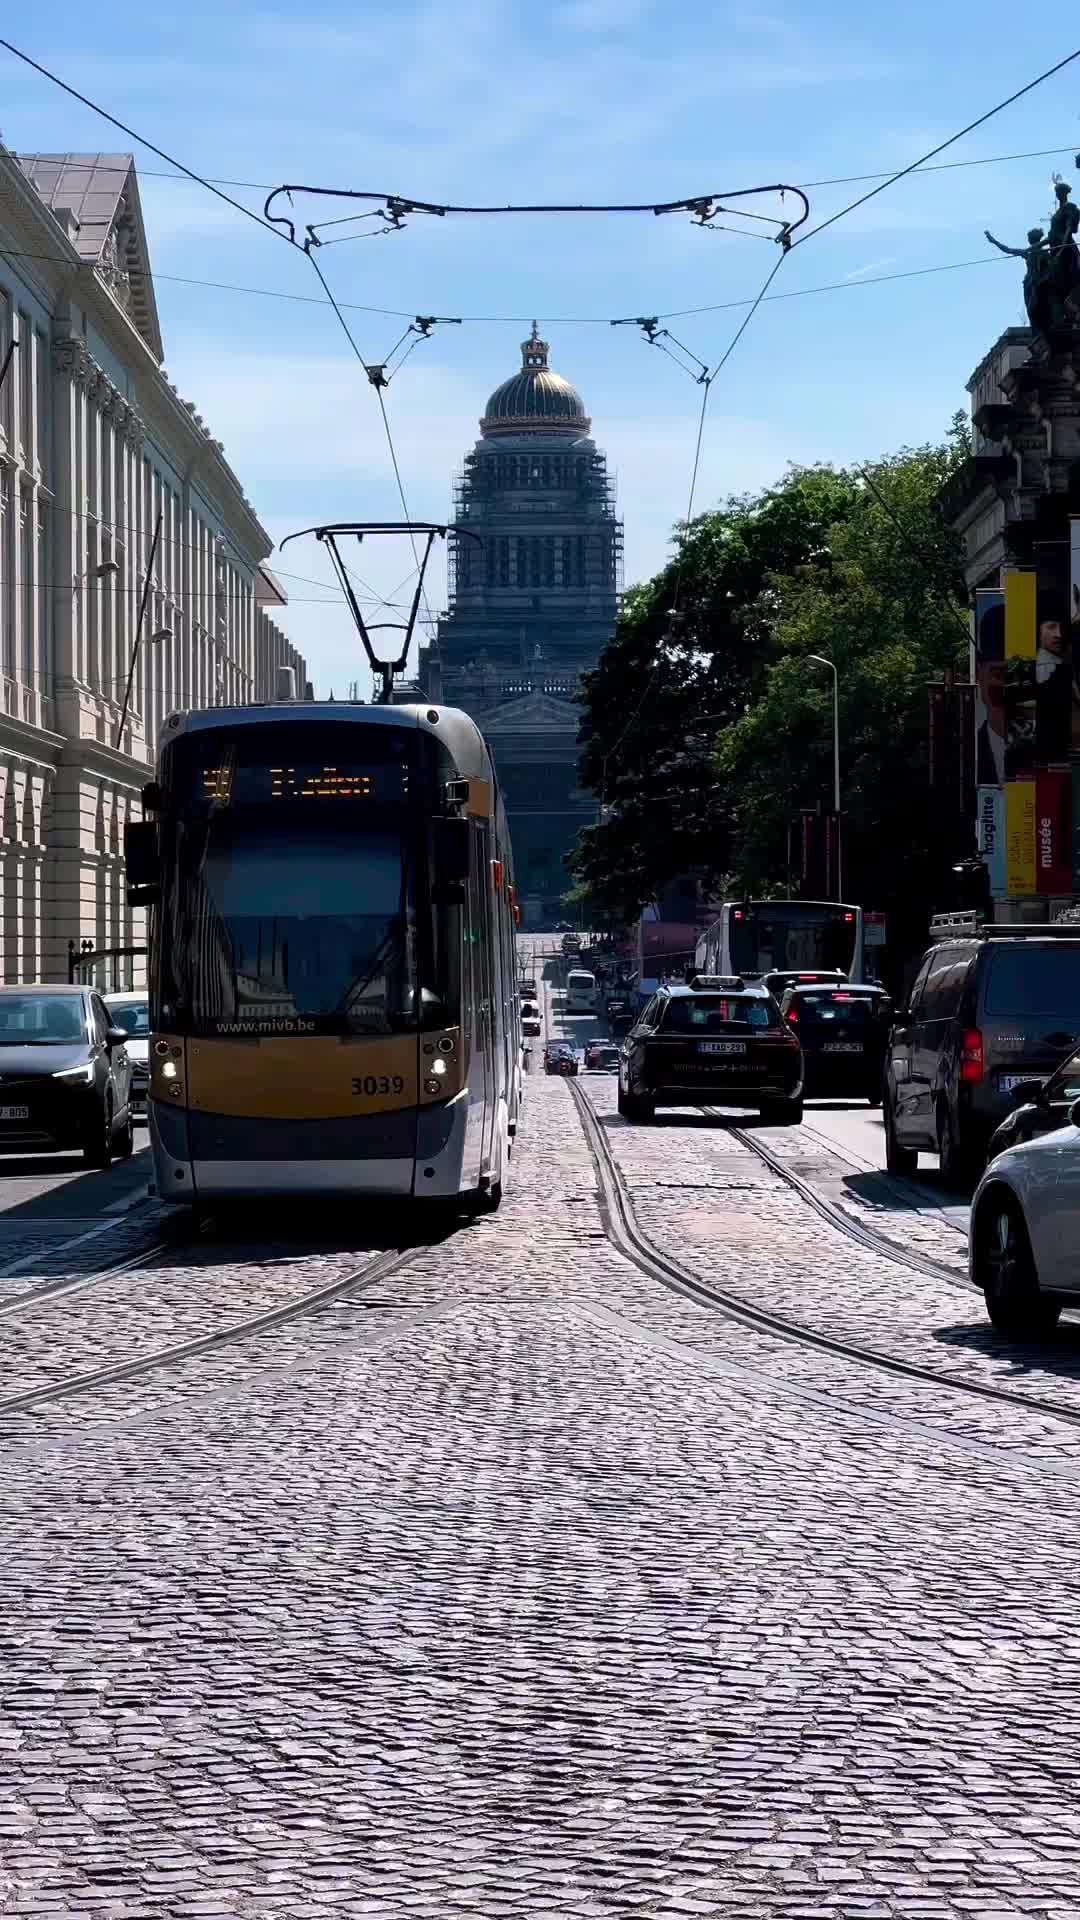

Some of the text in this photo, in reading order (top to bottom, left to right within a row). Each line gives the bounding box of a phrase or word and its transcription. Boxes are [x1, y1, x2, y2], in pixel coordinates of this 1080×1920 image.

[1040, 817, 1053, 869] musée
[216, 1019, 315, 1033] www.mivb.be
[352, 1075, 404, 1096] 3039
